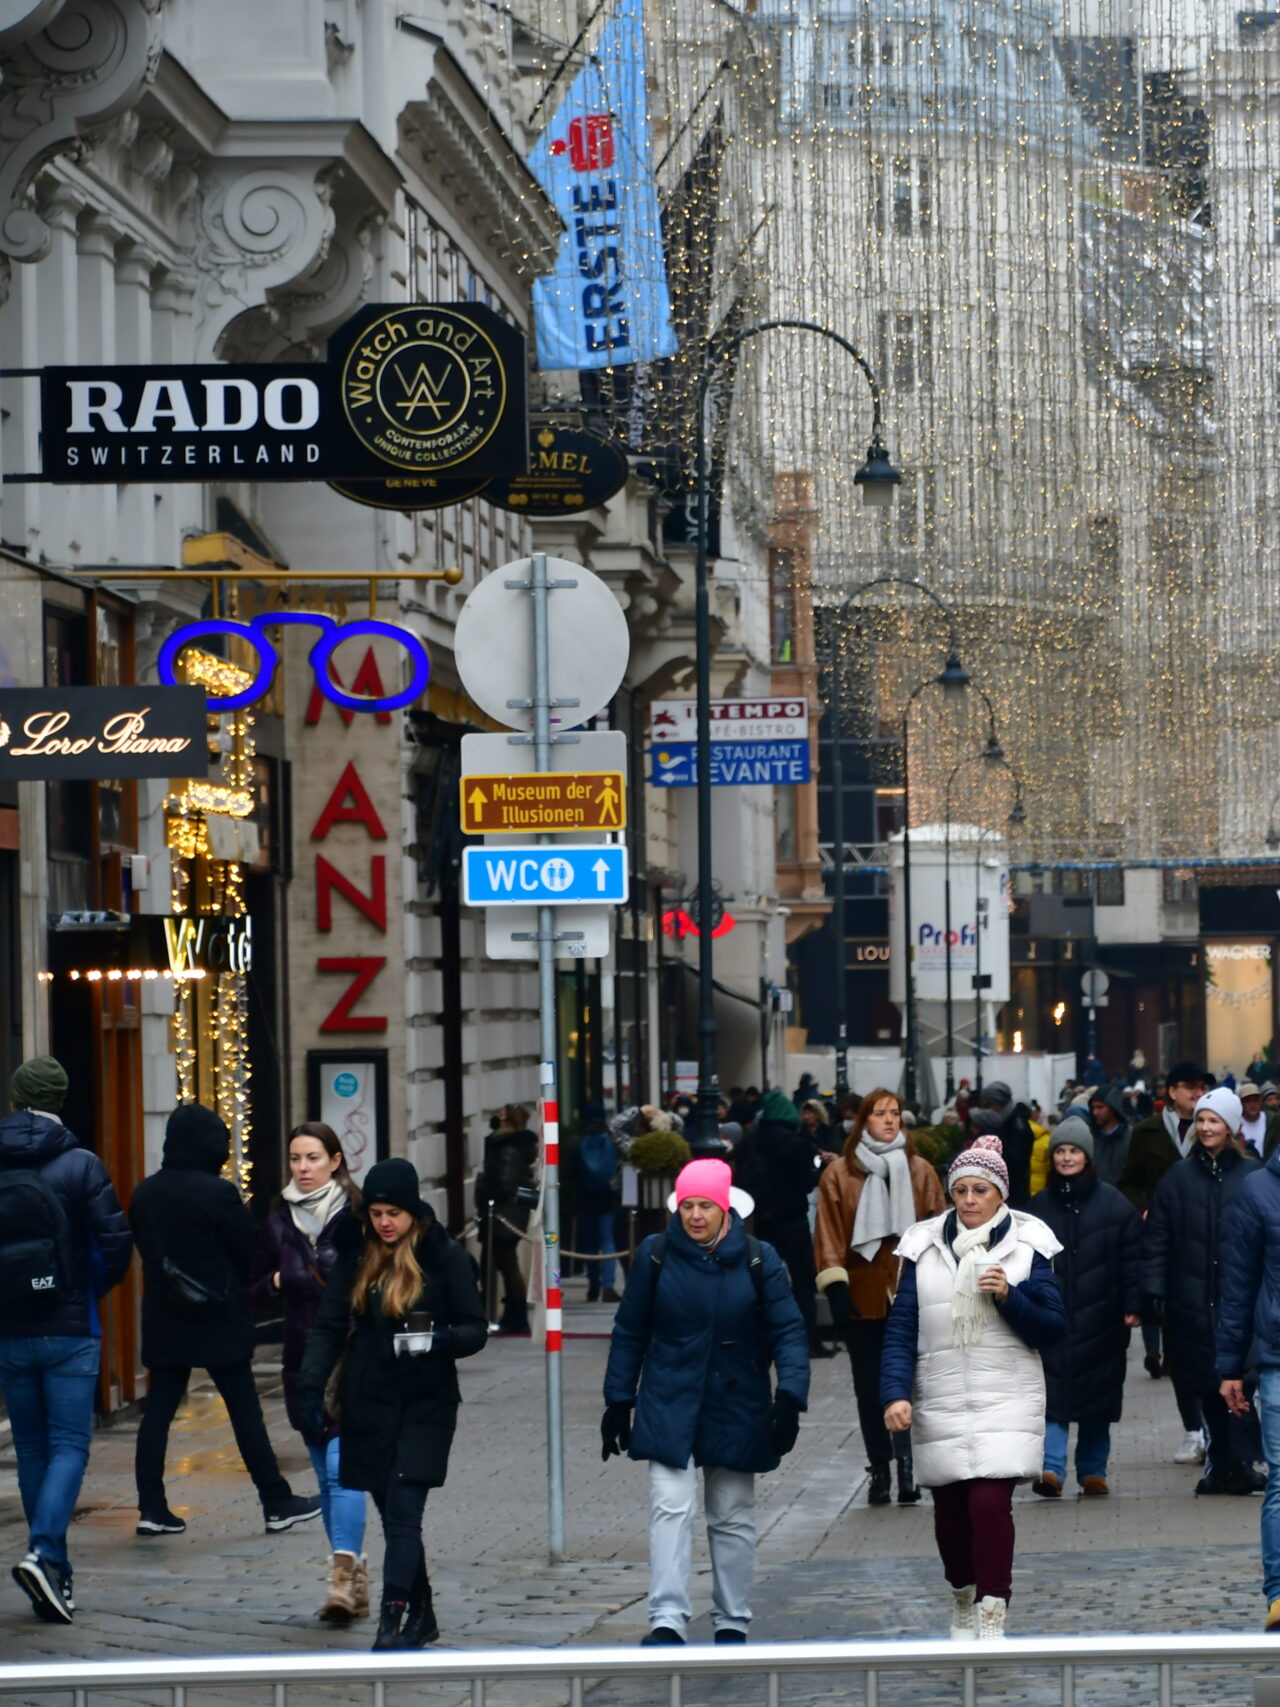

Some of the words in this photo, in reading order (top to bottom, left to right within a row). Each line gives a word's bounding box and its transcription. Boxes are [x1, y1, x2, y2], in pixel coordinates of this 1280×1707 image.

[573, 181, 631, 353] ERSTE
[348, 319, 408, 409] Watch
[416, 318, 478, 353] and
[468, 356, 495, 399] Art
[66, 378, 320, 433] RADO
[374, 434, 412, 461] UNIQUE
[415, 425, 484, 462] COLLECTIONS
[385, 420, 471, 449] CONTEMPORARY
[67, 444, 320, 466] SWITZERLAND
[711, 703, 801, 719] TEMPO
[10, 710, 96, 757] Loro
[97, 707, 192, 754] Piana
[696, 723, 797, 737] FÉ-BISTRO
[493, 783, 561, 801] Museum
[566, 782, 592, 799] der
[502, 806, 585, 824] Illusionen
[305, 644, 393, 1032] MANZ
[486, 859, 539, 892] WC
[919, 924, 978, 946] Profi
[1205, 944, 1272, 960] WAGNER
[31, 1276, 54, 1290] EA7
